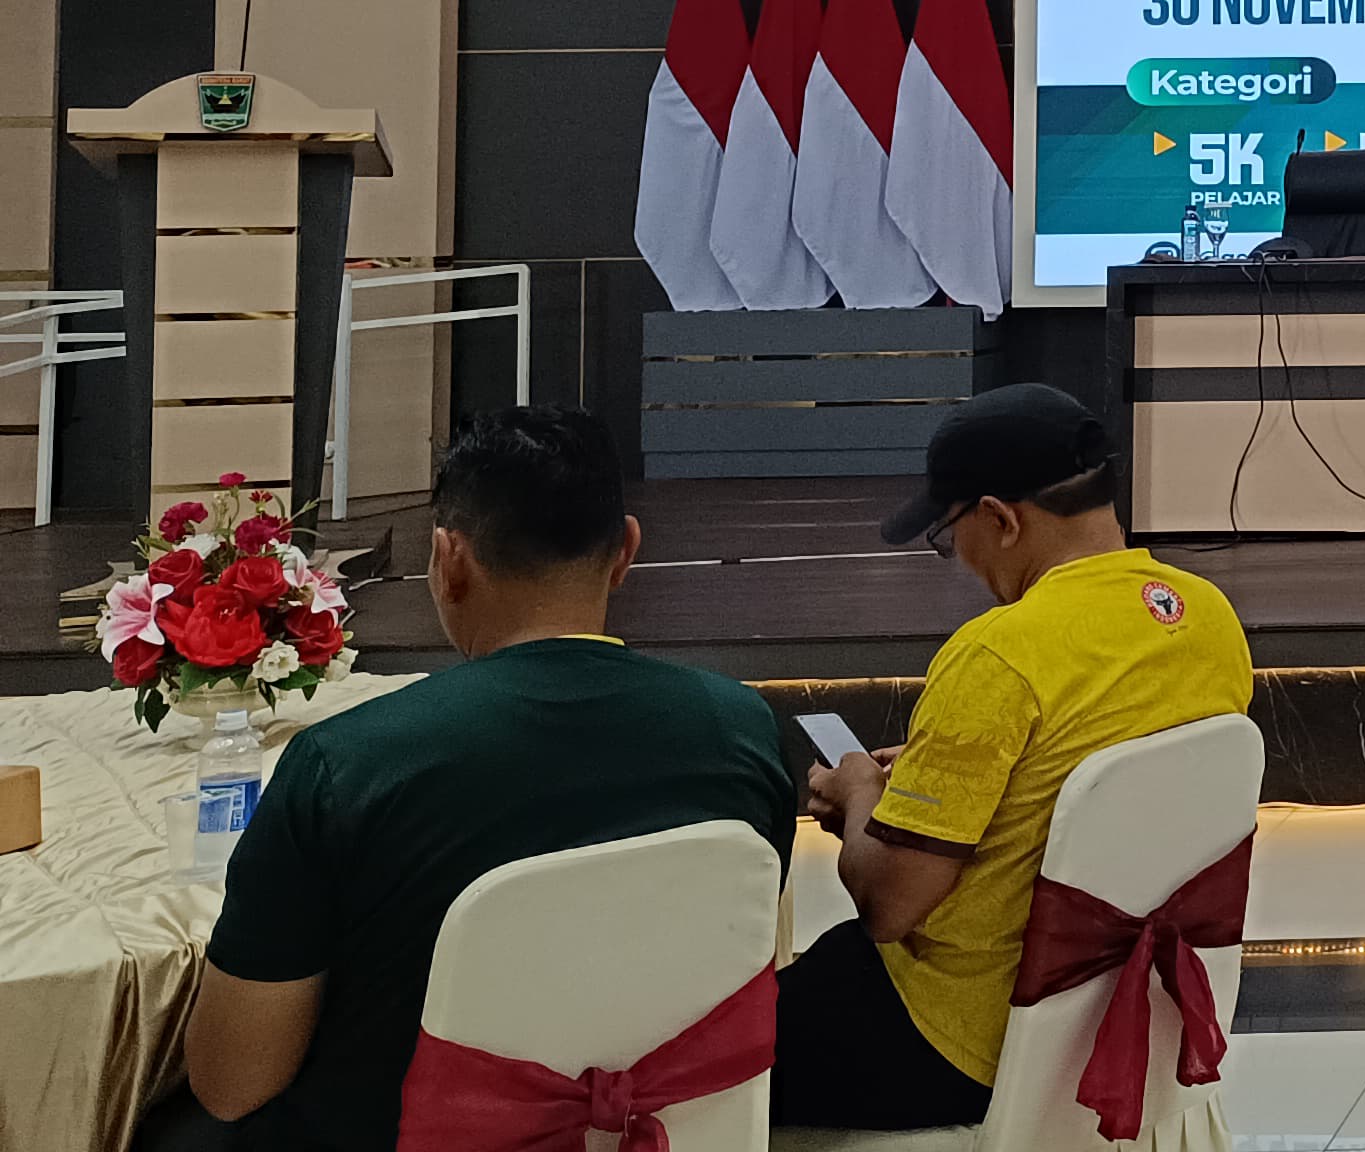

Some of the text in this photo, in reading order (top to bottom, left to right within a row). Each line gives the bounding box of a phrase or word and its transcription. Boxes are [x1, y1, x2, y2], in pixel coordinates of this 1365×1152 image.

[1151, 66, 1312, 100] Kategori
[1189, 132, 1264, 185] 5K
[1190, 191, 1281, 206] PELAJAR
